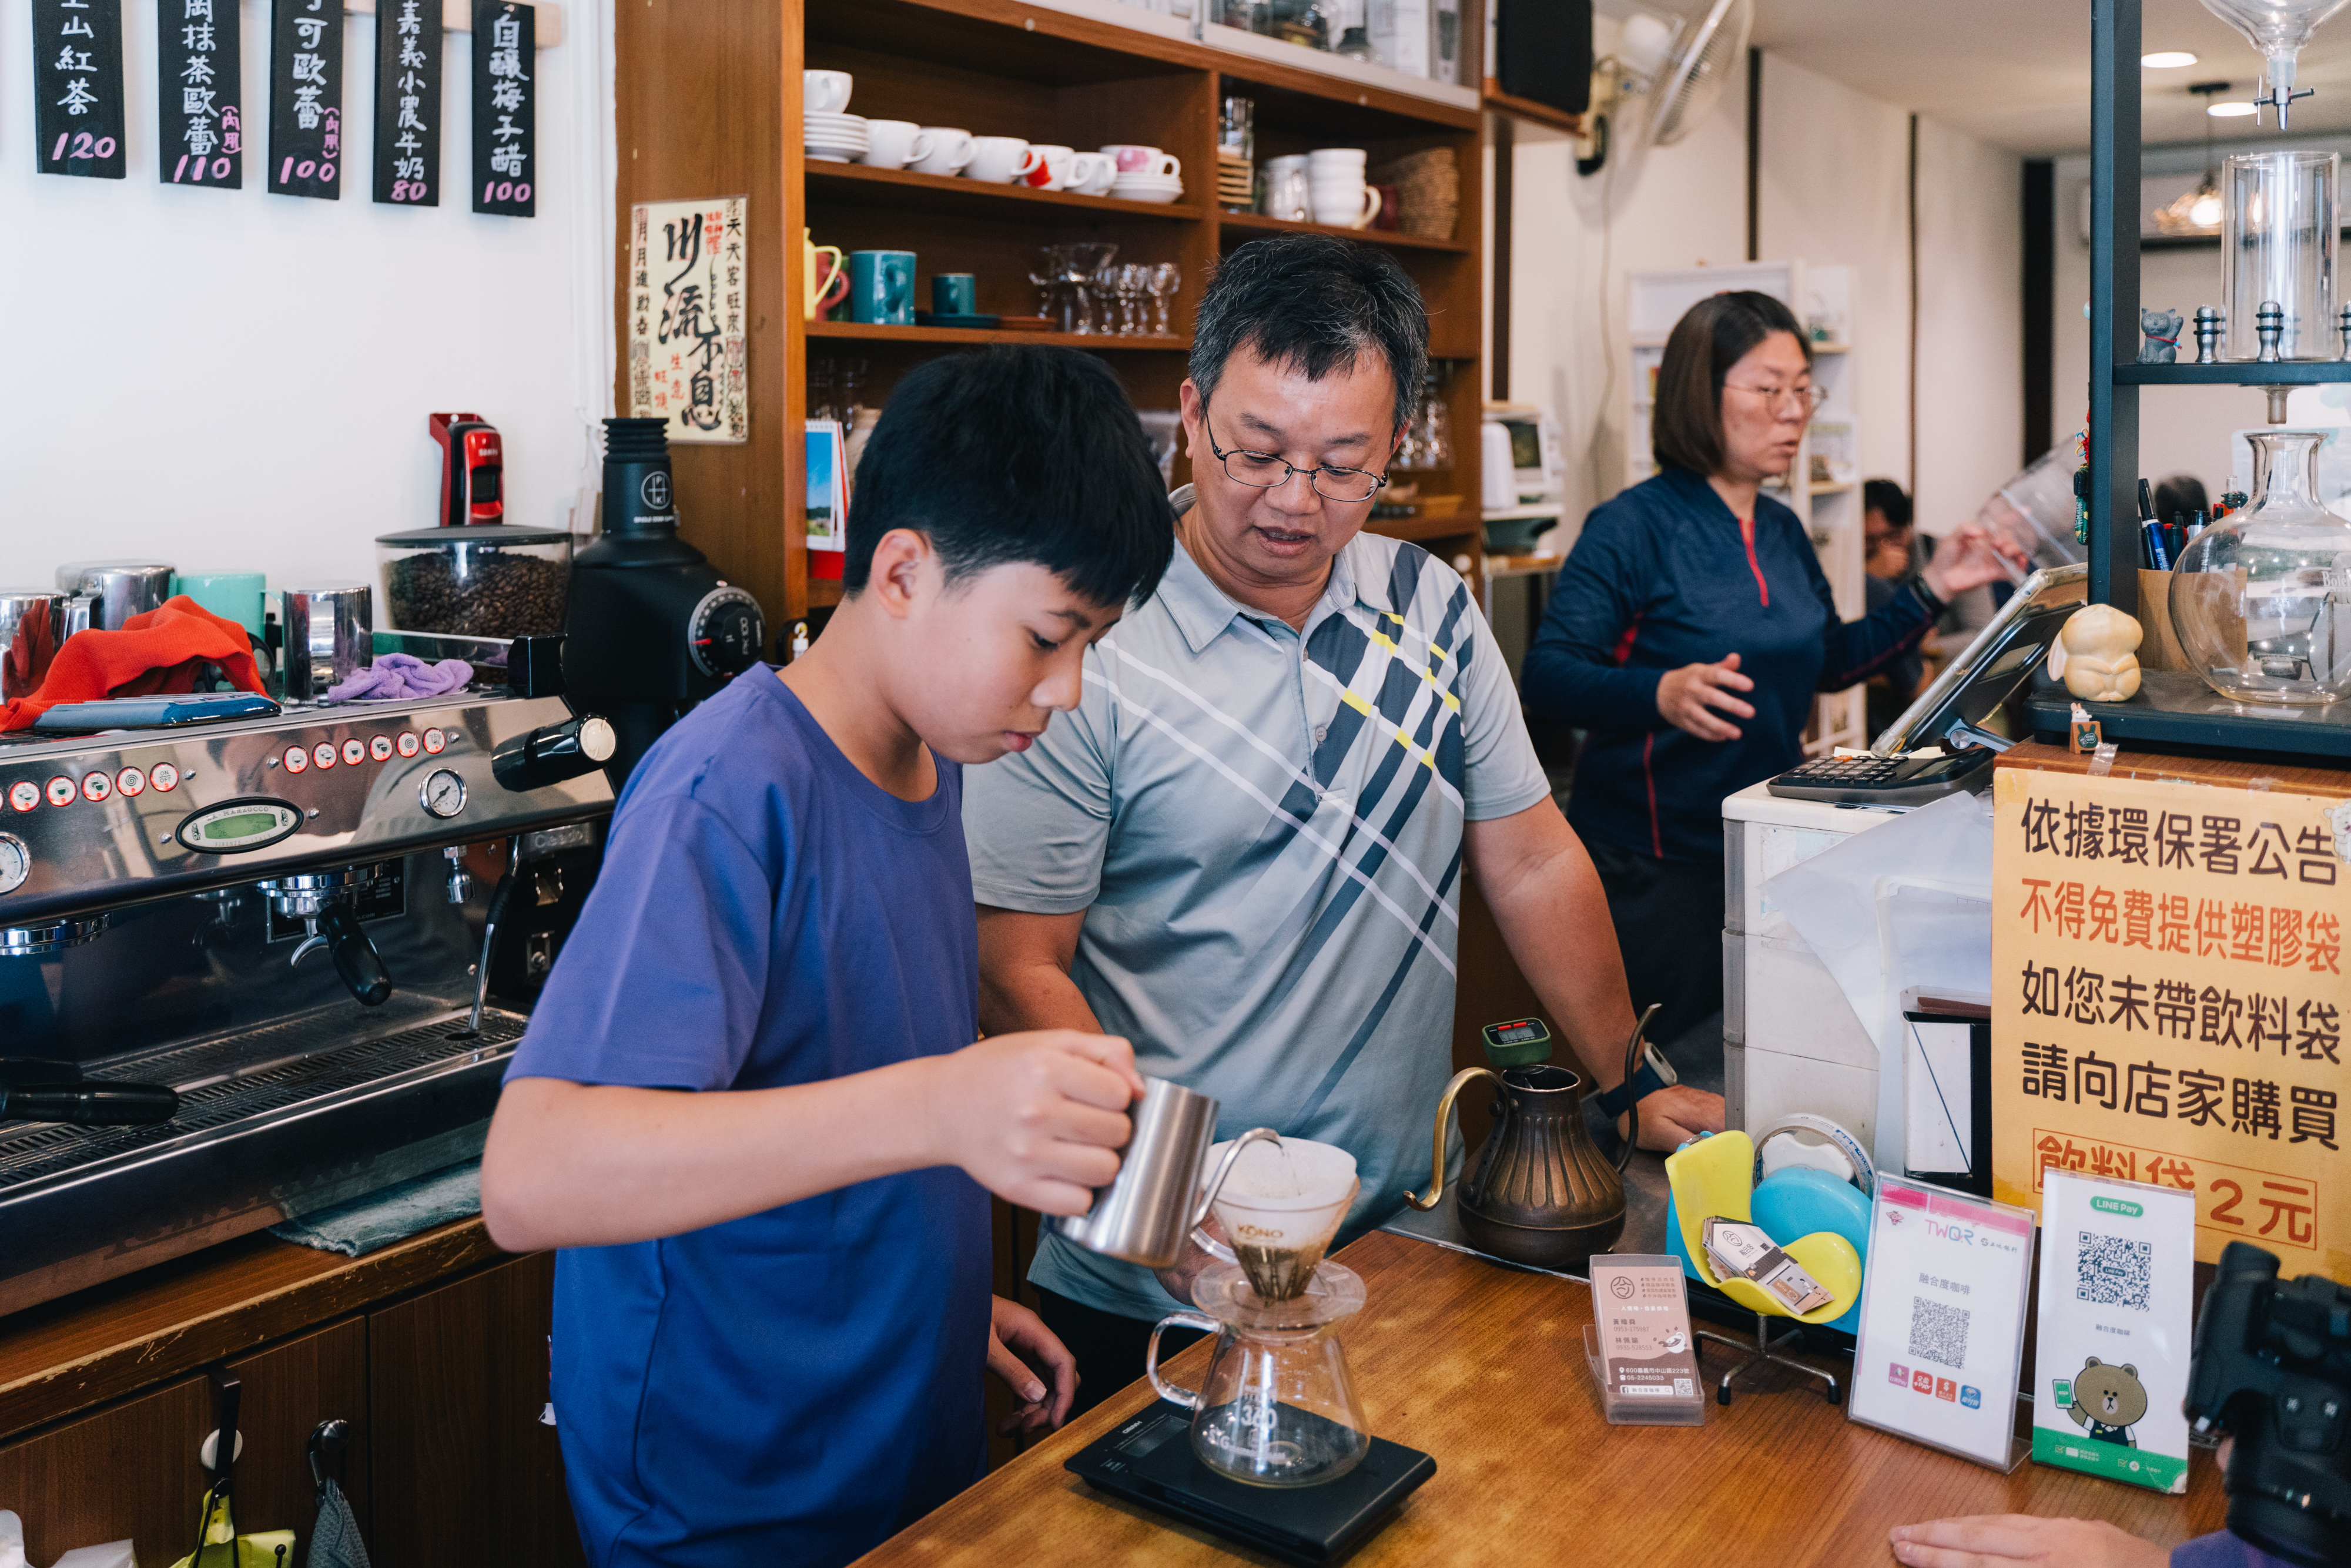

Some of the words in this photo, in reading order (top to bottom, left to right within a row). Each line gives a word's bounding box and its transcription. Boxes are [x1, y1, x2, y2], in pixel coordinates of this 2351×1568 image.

[292, 0, 329, 130] 可歐蕾
[393, 0, 427, 180] 嘉義小農牛奶
[489, 14, 530, 177] 自釀梅子醋
[52, 132, 116, 161] 120
[173, 155, 231, 183] 110
[279, 156, 336, 185] 100
[390, 179, 427, 201] 80
[483, 180, 531, 204] 100
[726, 218, 742, 333] 天天客旺來
[2021, 797, 2337, 886] 依據環保署公告
[2020, 878, 2340, 975] 不得免費提供塑膠袋
[2021, 959, 2340, 1064] 如您未帶飲料袋
[2021, 1041, 2339, 1151] 請向店家購買
[2097, 1200, 2119, 1211] LINE
[2120, 1203, 2138, 1215] Pay
[1990, 1242, 2018, 1254] 土地銀行
[1919, 1272, 1971, 1296] 融合度咖啡
[1122, 1420, 1143, 1434] HARIO
